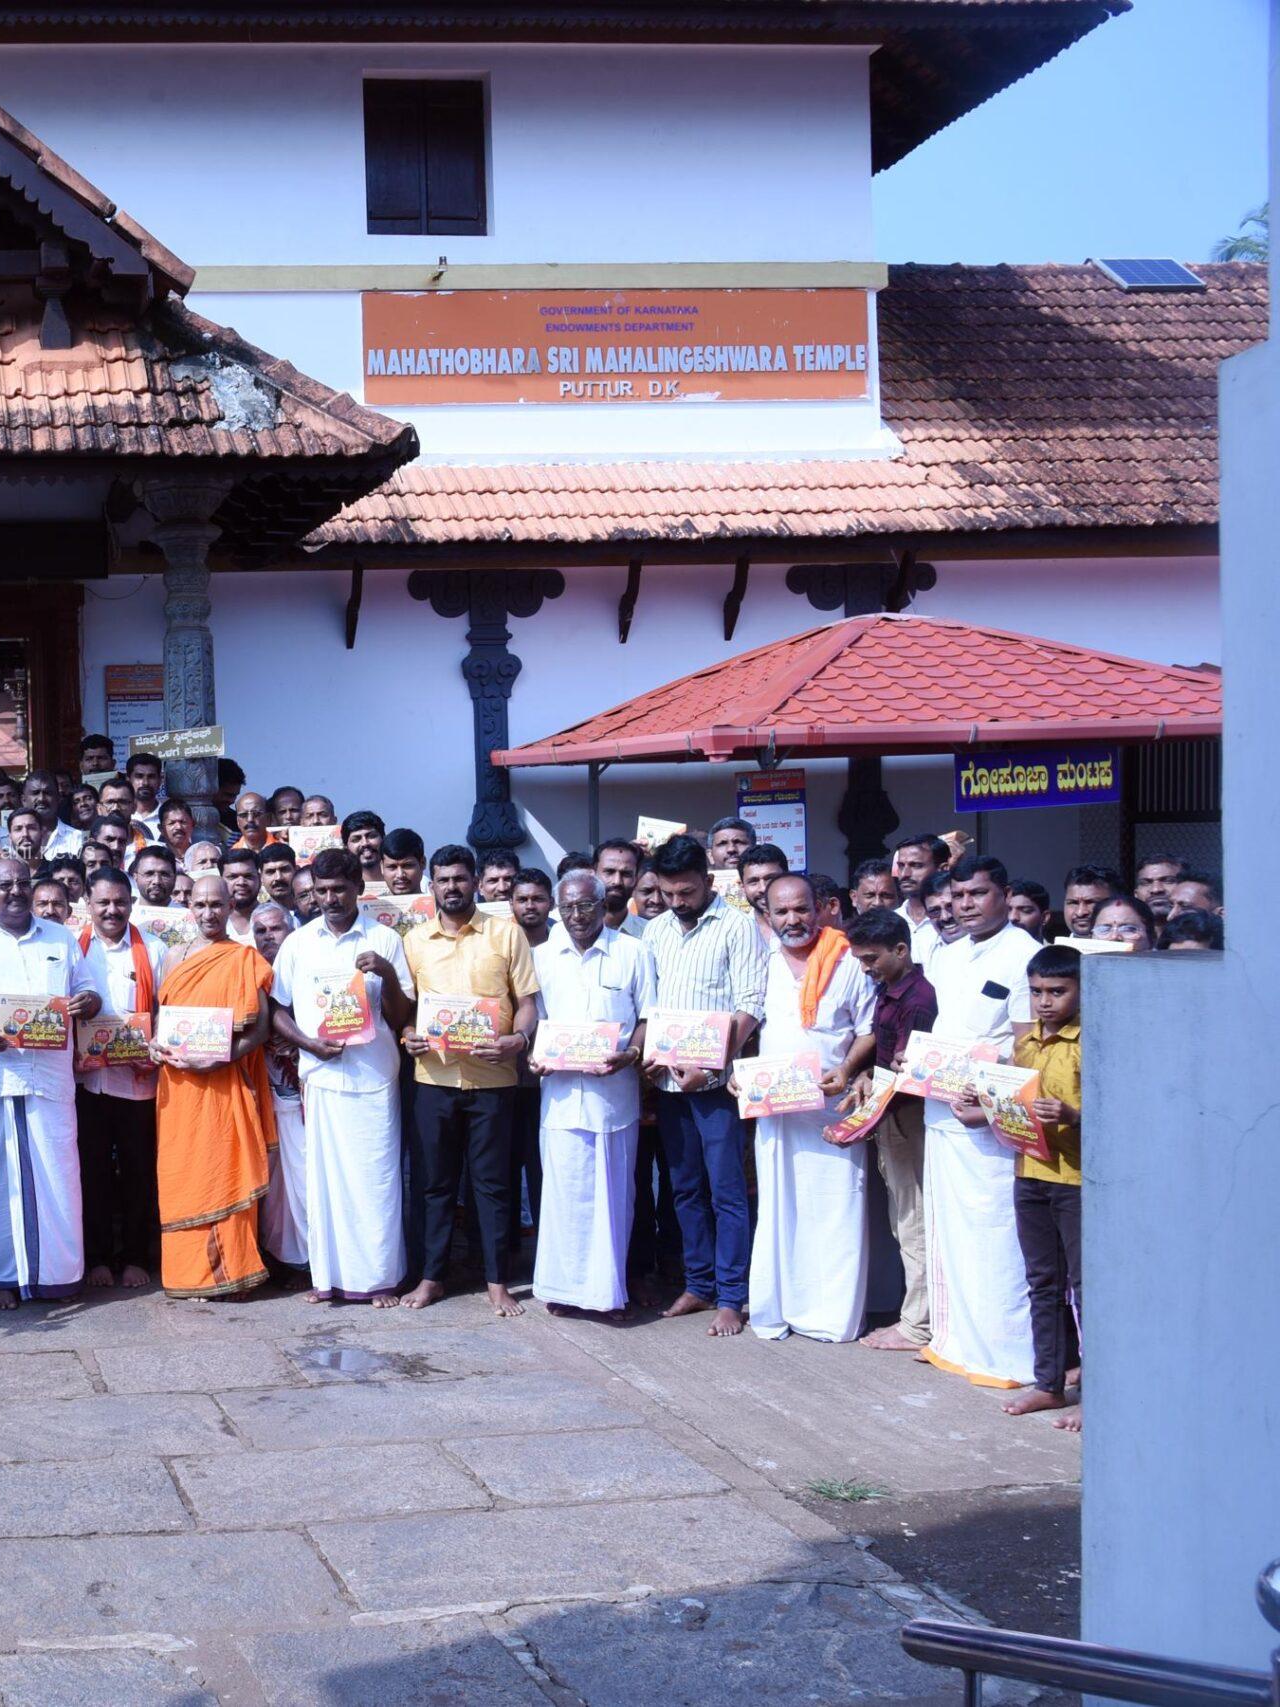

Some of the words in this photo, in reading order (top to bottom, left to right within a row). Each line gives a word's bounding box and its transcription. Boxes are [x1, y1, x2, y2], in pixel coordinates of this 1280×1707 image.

[539, 305, 613, 316] GOVERNMENT
[617, 305, 631, 315] OF
[634, 305, 699, 315] KARNATAKA
[545, 323, 621, 332] ENDOWMENTS
[624, 322, 695, 332] DEPARTMENT
[367, 347, 542, 376] MAHATHOBHARA
[547, 346, 579, 374] SRI
[585, 345, 789, 374] MAHALINGESHWARA
[793, 344, 866, 371] TEMPLE
[960, 759, 1049, 798] ಗೋಪೂಜಾ
[1056, 752, 1114, 792] ಮಂಟಪ
